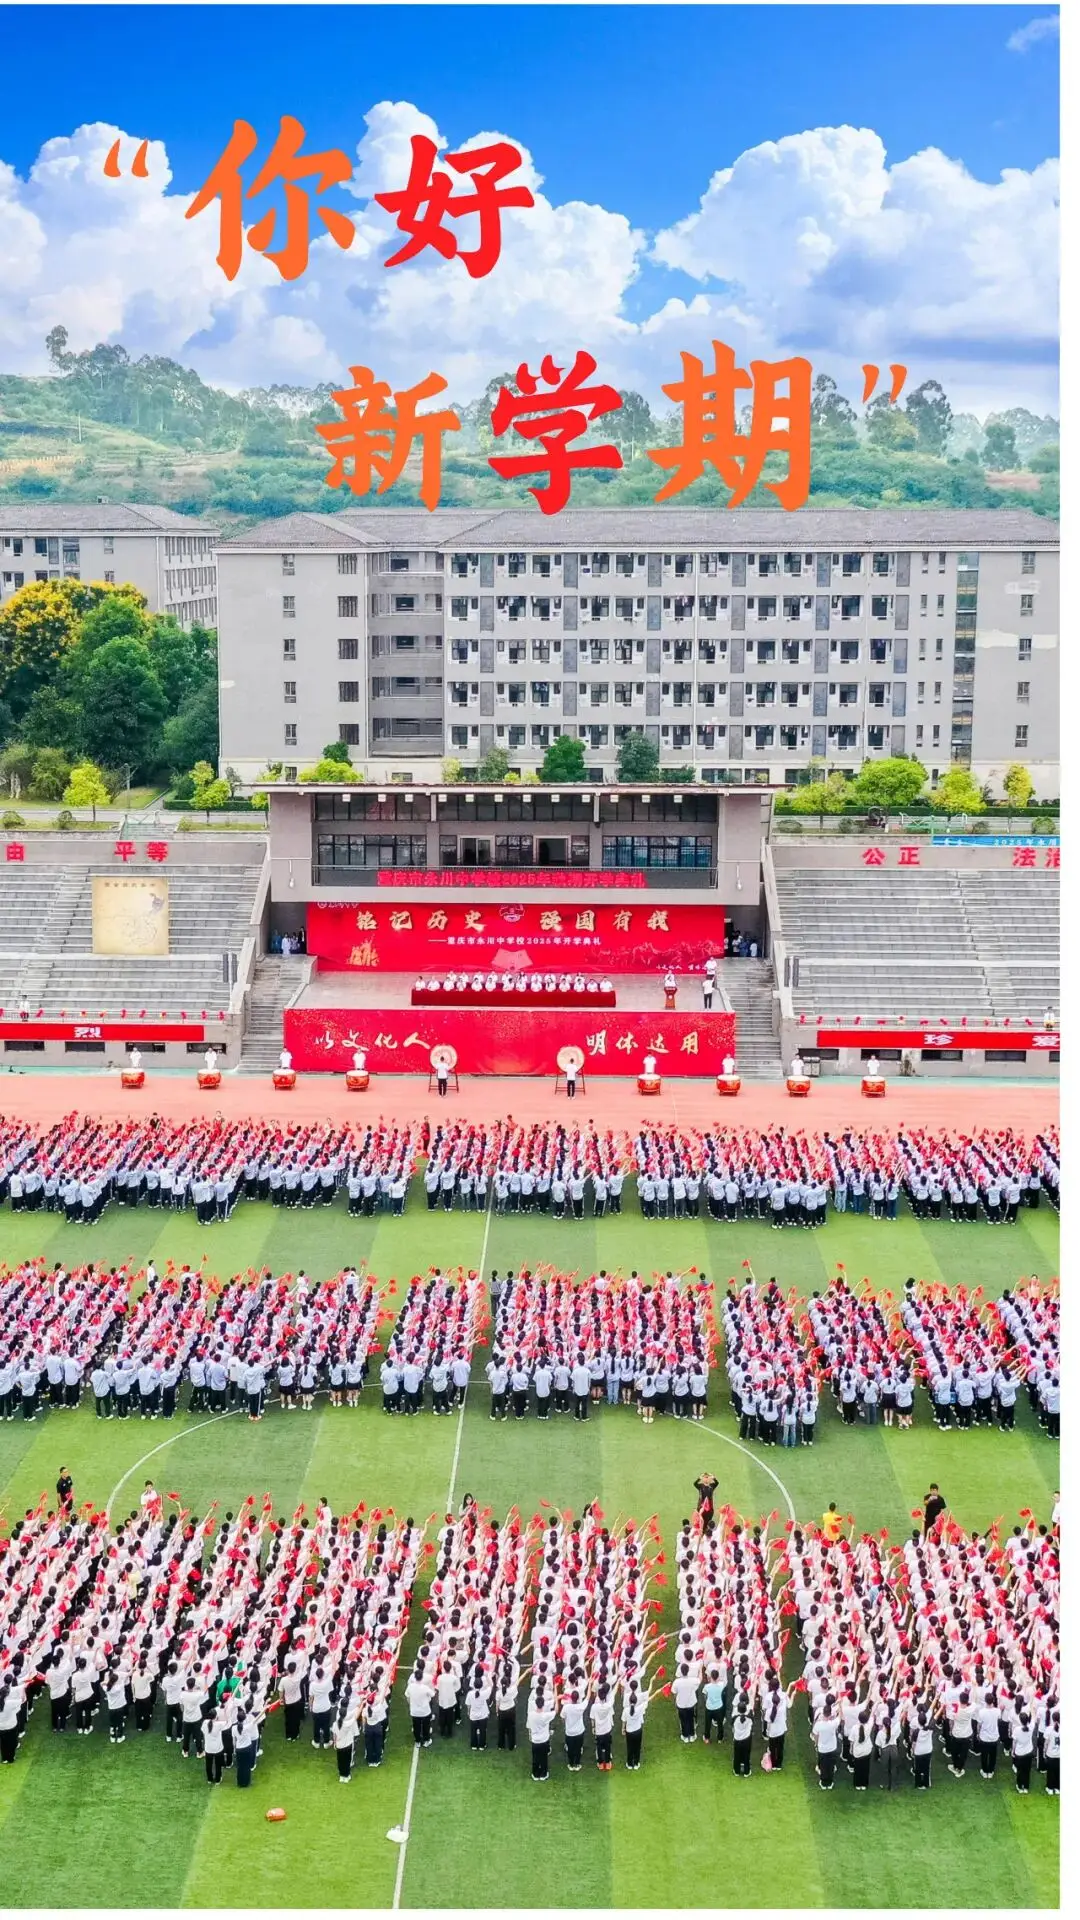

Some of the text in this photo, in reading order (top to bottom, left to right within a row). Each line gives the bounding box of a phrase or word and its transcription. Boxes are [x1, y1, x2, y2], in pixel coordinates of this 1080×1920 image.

[6, 841, 169, 862] 由 平等
[862, 846, 920, 866] 公正
[356, 908, 670, 933] 铭记历史 强国有我
[315, 1029, 700, 1056] 以文化人 明体达用
